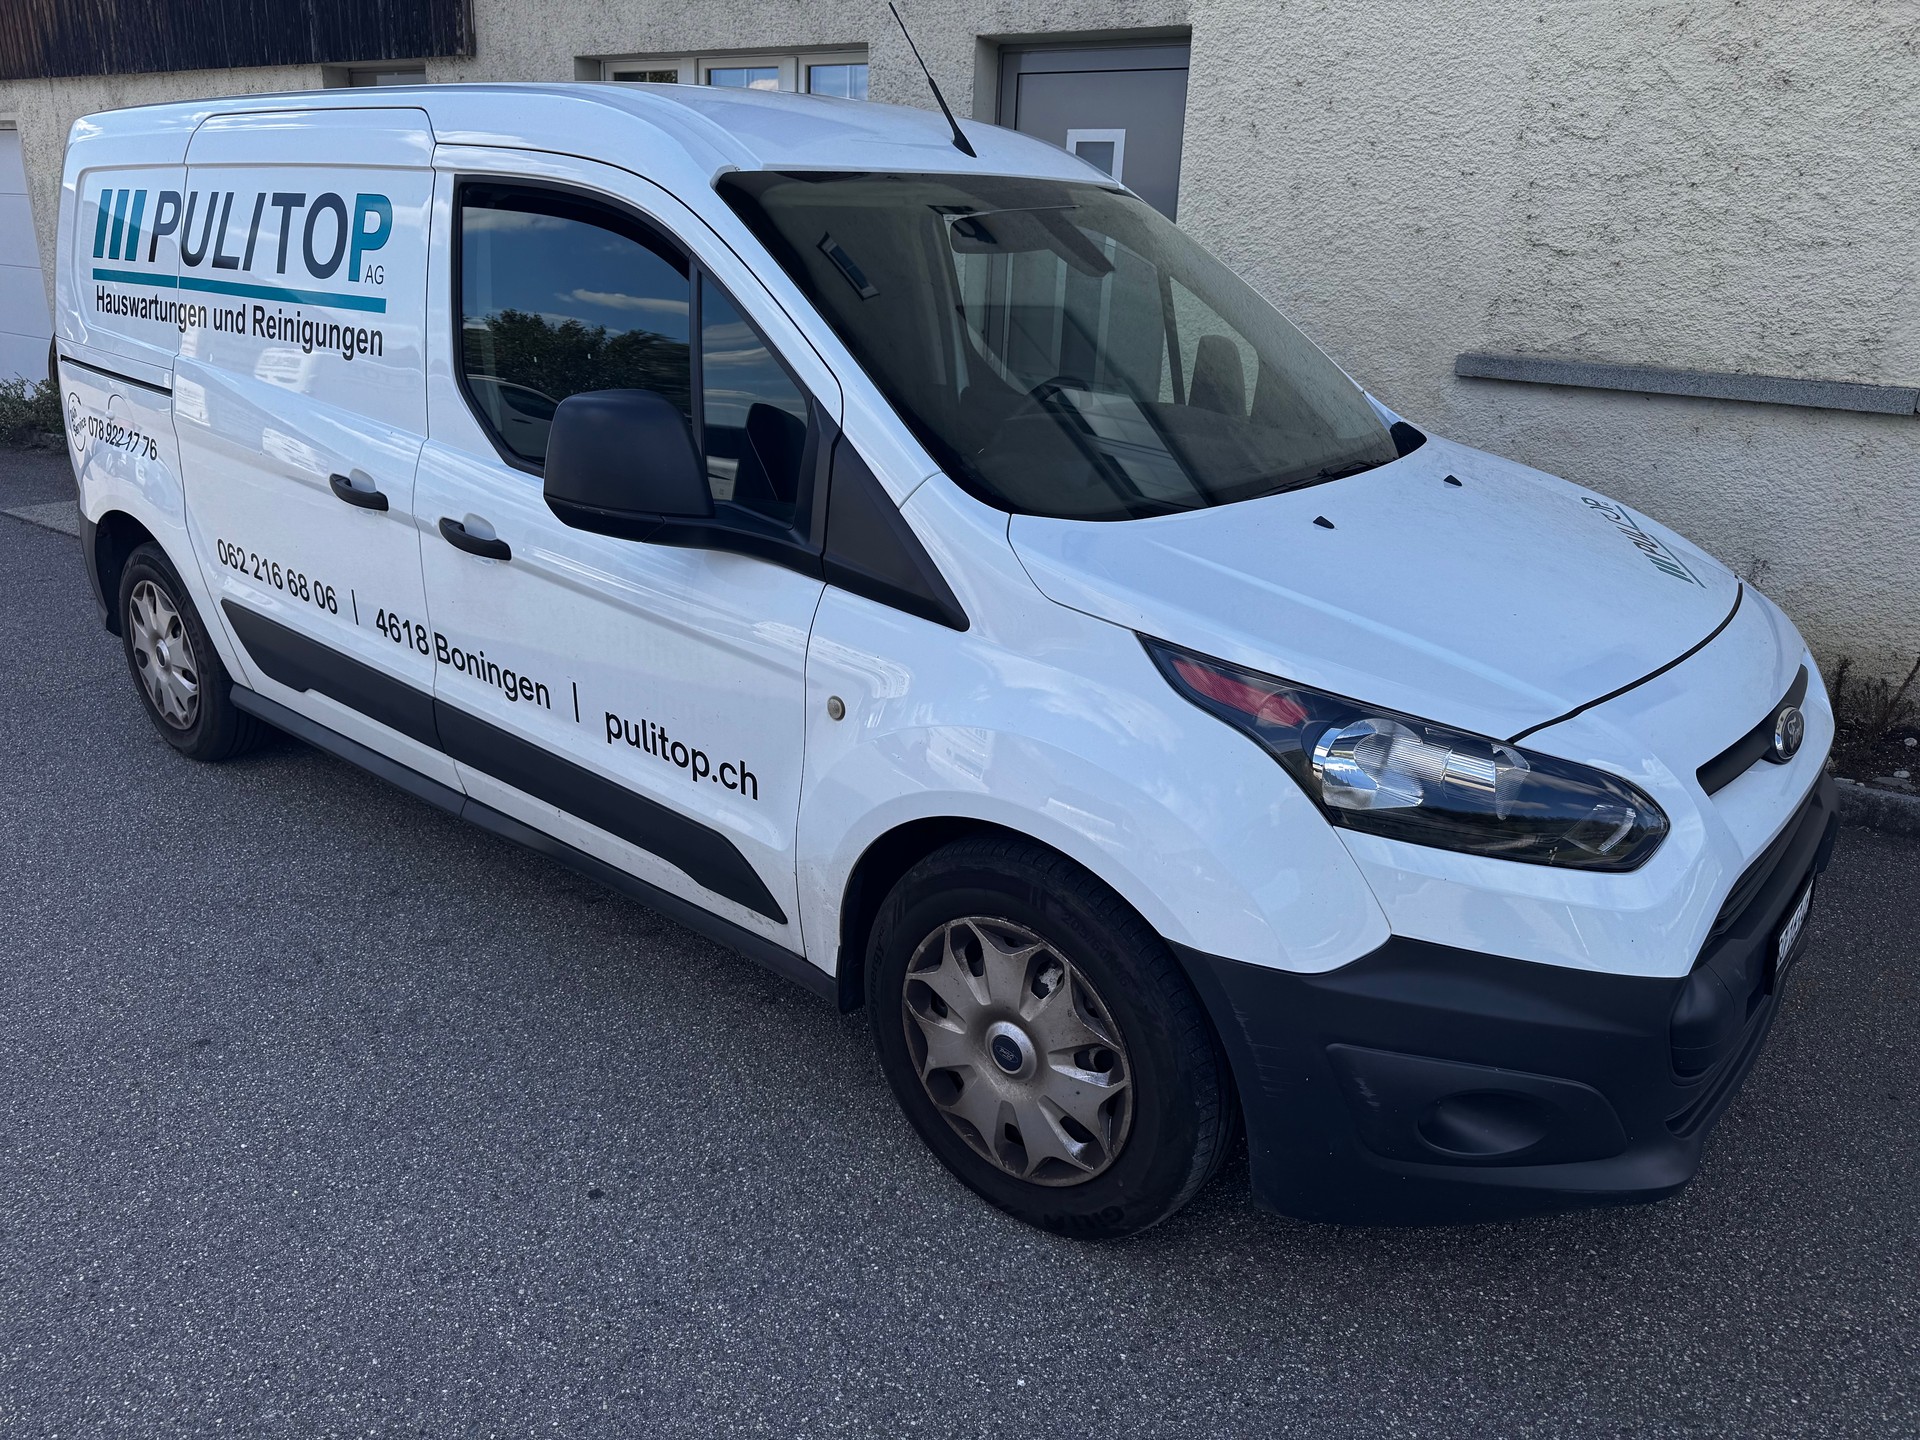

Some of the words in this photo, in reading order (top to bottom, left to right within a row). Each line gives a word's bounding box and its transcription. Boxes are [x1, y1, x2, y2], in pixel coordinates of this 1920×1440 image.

[148, 190, 393, 282] PULITOP
[364, 265, 385, 285] AG
[95, 284, 208, 334] Hauswartungen
[213, 303, 247, 335] und
[252, 304, 384, 361] Reinigungen
[88, 416, 104, 440] 078
[105, 422, 124, 448] 922
[125, 431, 140, 453] 17
[141, 436, 158, 461] 76
[217, 538, 250, 575] 062
[251, 553, 284, 590] 216
[287, 568, 311, 601] 68
[313, 580, 338, 615] 06
[376, 608, 430, 656] 4618
[433, 631, 551, 709] Boningen
[605, 711, 759, 801] pulitop.ch
